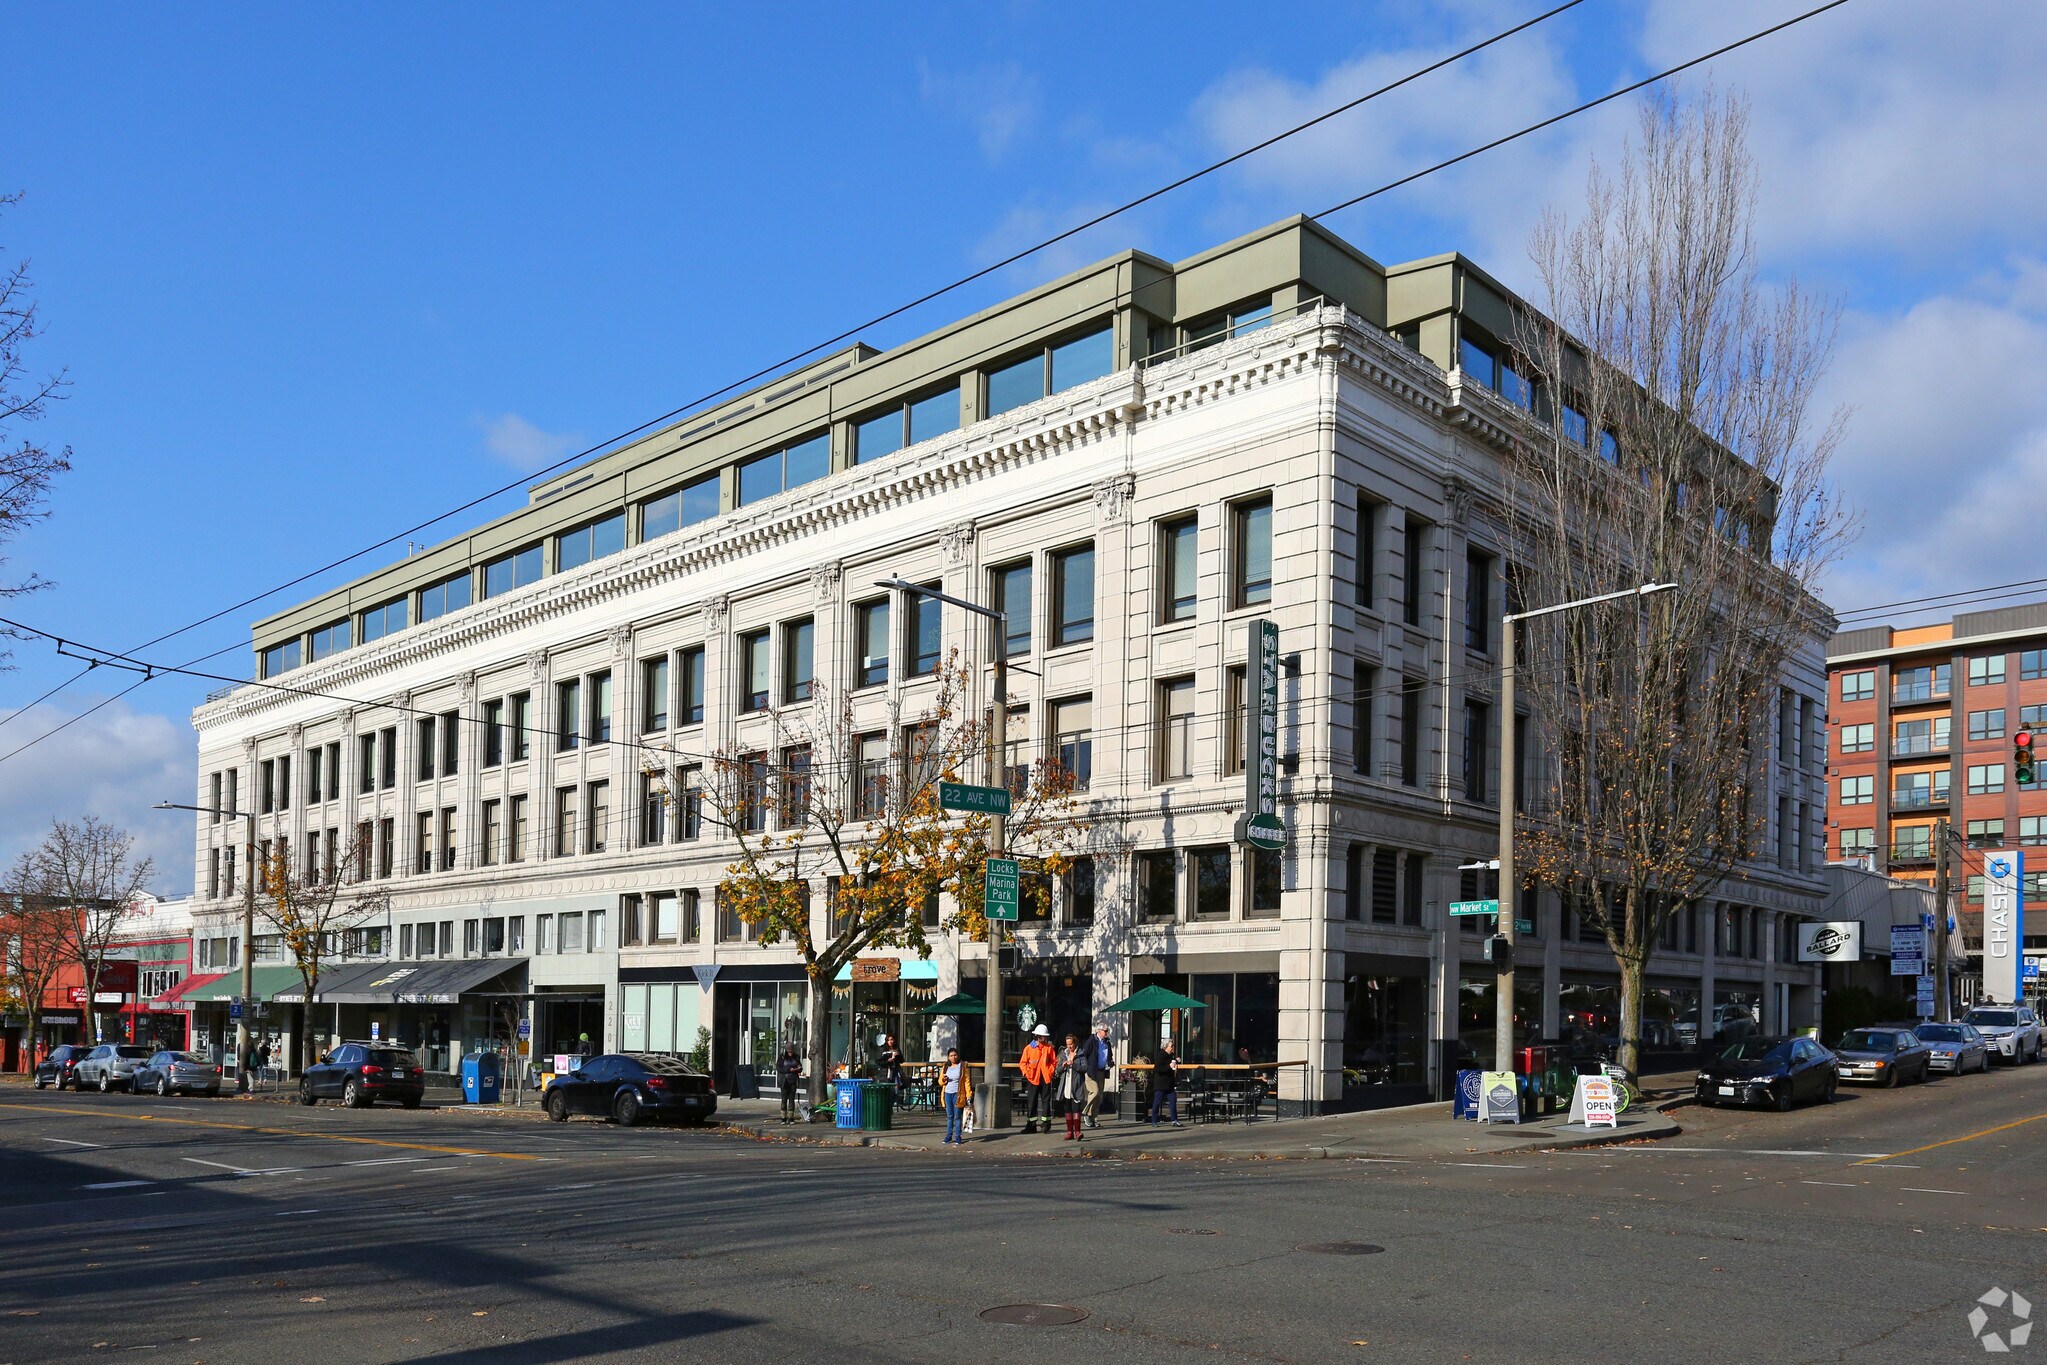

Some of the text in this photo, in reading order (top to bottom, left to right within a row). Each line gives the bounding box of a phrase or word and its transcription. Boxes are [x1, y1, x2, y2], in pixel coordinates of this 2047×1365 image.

[1261, 633, 1278, 815] STARBUCKS
[944, 788, 1006, 808] 22 AVE NW
[1249, 824, 1286, 843] COFFEE
[991, 861, 1014, 875] Locks
[989, 876, 1015, 889] Marina
[992, 888, 1011, 901] Park
[1460, 903, 1482, 912] Market
[1990, 880, 2008, 958] CHASE
[1806, 933, 1851, 953] BALLARD
[863, 964, 887, 975] trove
[1586, 1101, 1612, 1110] OPEN
